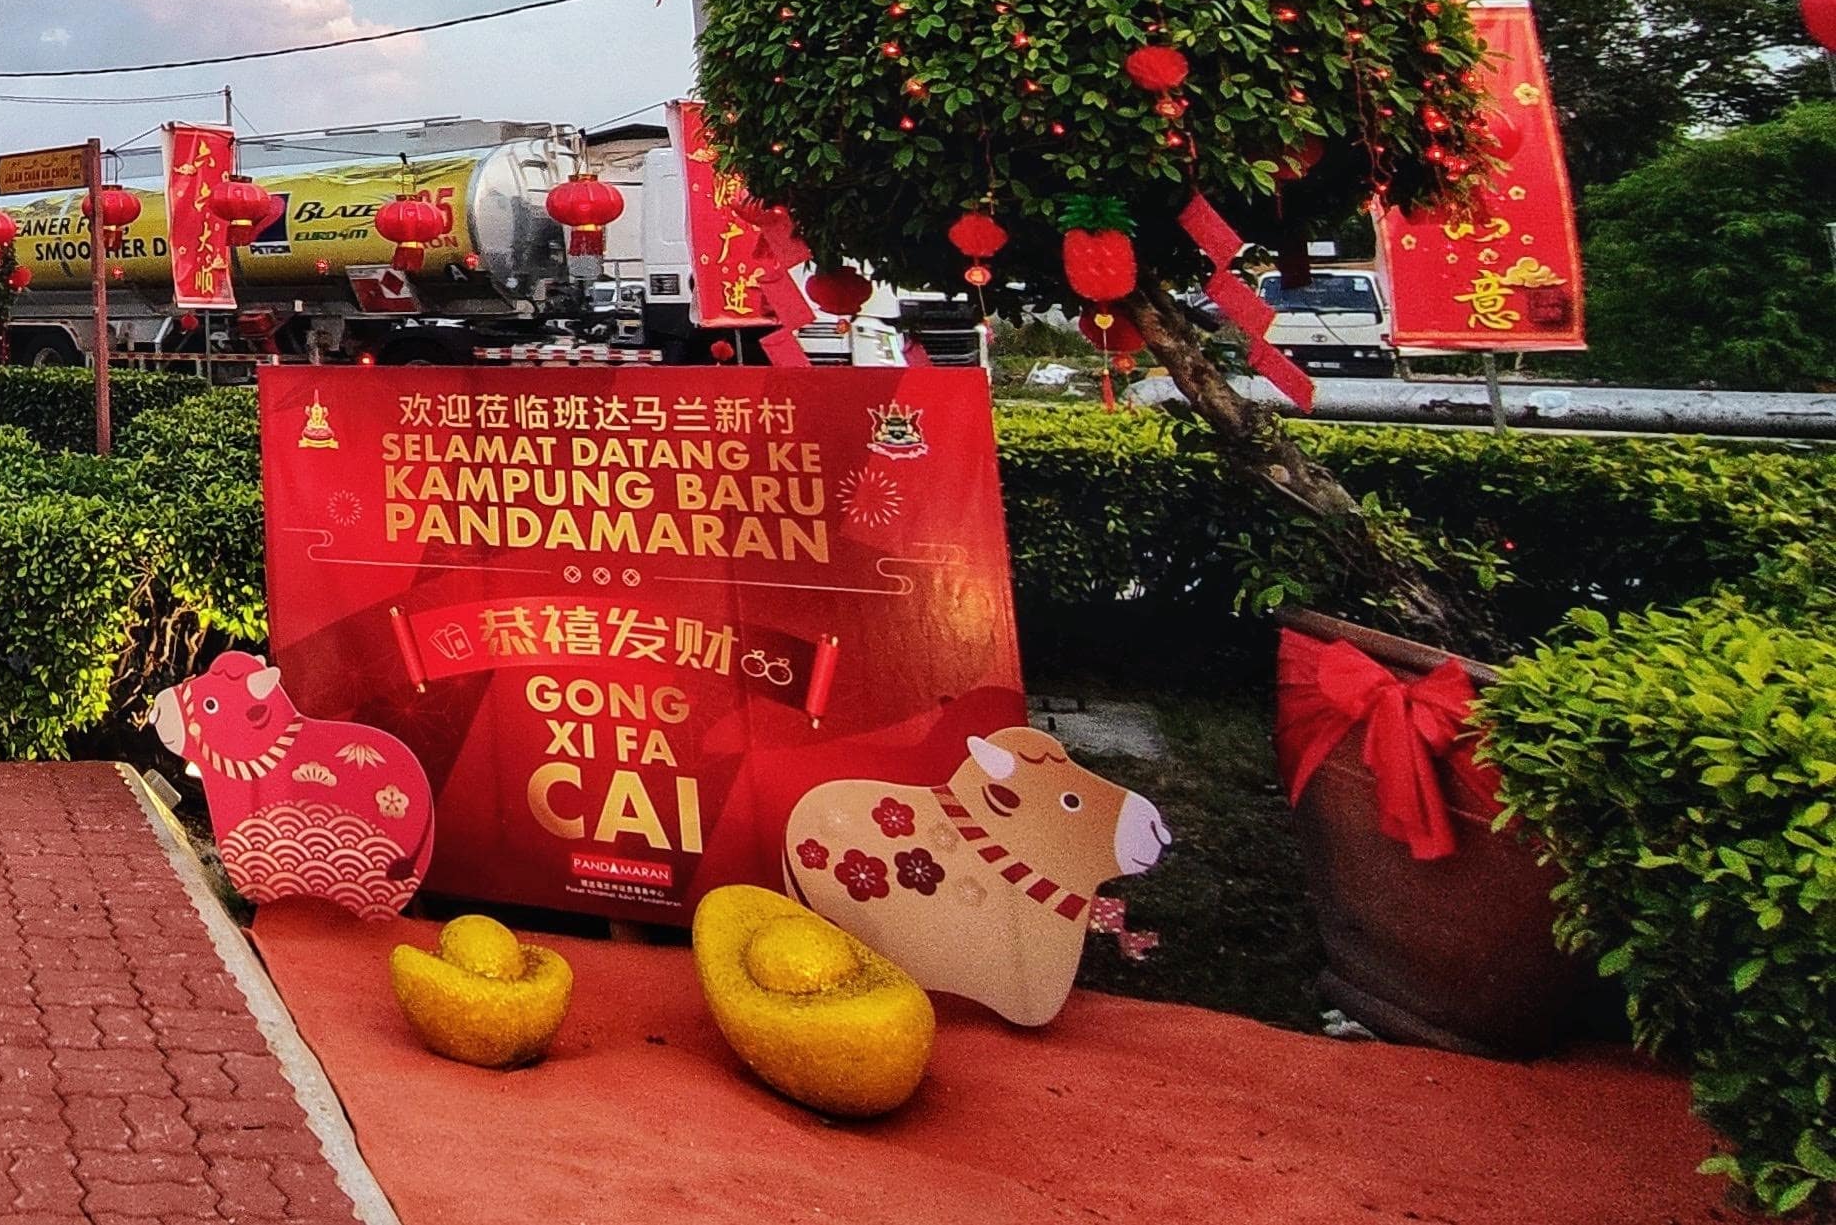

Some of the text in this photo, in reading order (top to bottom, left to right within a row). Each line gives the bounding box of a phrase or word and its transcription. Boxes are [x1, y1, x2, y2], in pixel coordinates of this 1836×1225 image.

[35, 238, 147, 261] SMOOHER
[398, 393, 796, 434] 欢迎莅临班达马兰新村
[382, 433, 822, 474] SELAMAT DATANG KE
[384, 466, 826, 518] KAMPUNG BARU
[385, 503, 831, 564] PANDAMARAN
[478, 604, 740, 676] 恭禧发财
[526, 675, 691, 724] GONG
[544, 719, 678, 767] XI FA
[526, 762, 704, 855] CAI
[573, 857, 670, 880] PANDAMARAN
